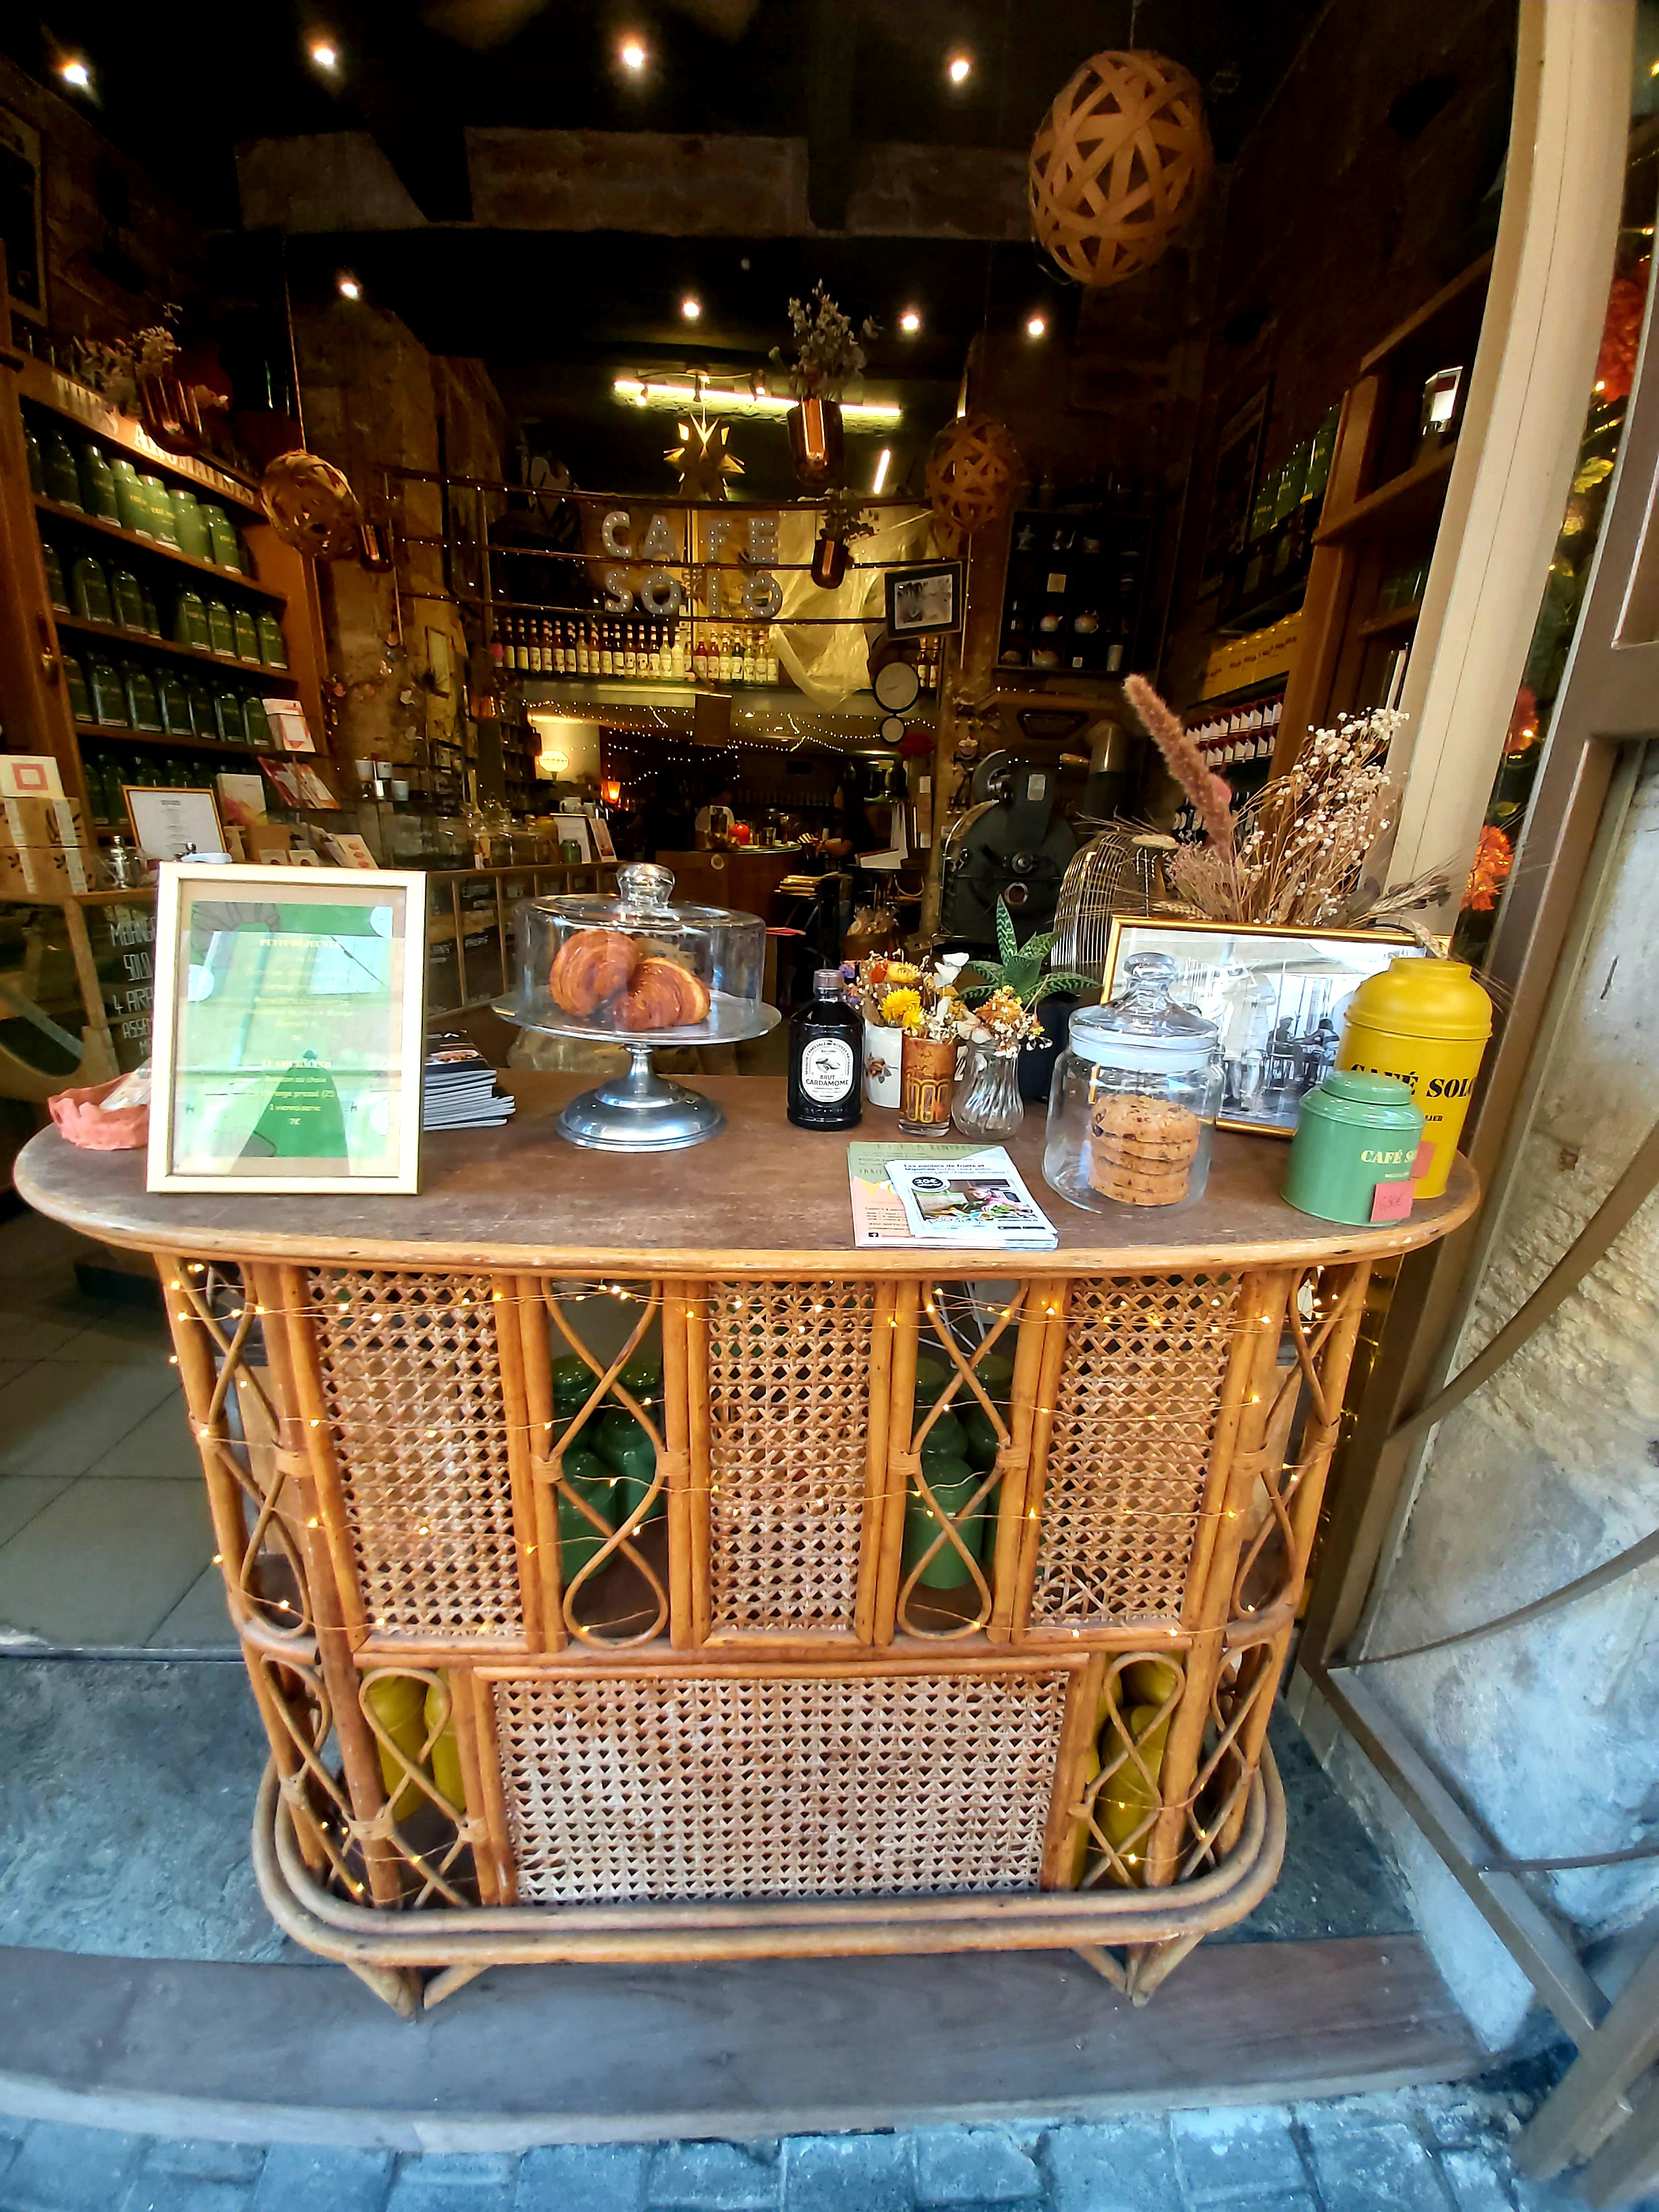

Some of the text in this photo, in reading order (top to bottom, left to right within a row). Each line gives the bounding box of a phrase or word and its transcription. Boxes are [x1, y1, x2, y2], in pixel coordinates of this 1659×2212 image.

[601, 510, 779, 565] CAFE
[805, 1078, 849, 1086] CARDAMOME
[1360, 1149, 1403, 1164] CAFÉ
